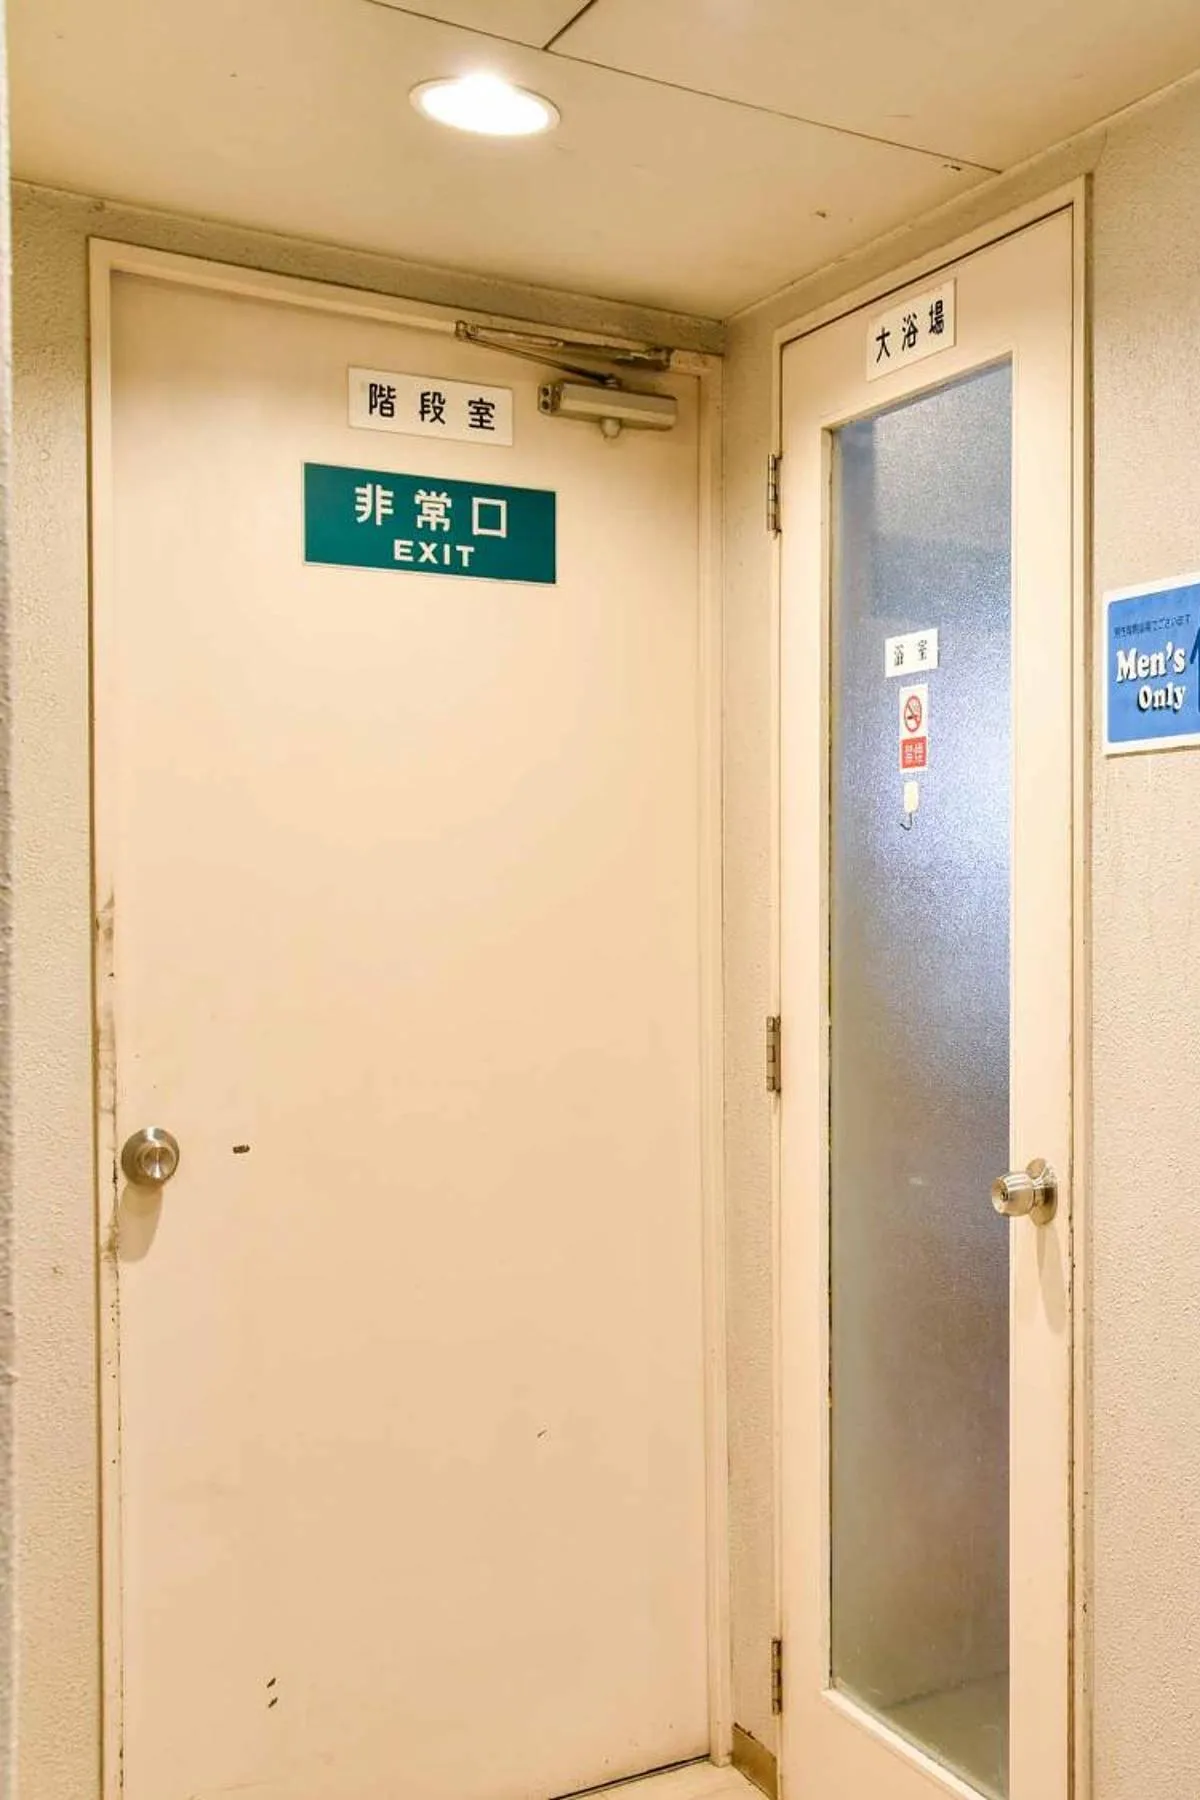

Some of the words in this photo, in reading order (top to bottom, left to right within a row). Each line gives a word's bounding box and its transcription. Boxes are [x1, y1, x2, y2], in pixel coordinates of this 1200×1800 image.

[875, 299, 945, 364] 大浴場
[368, 382, 496, 431] 階段室
[354, 483, 508, 539] 非常口
[393, 539, 476, 568] EXIT
[1116, 641, 1187, 683] Men's
[1137, 682, 1187, 713] Only
